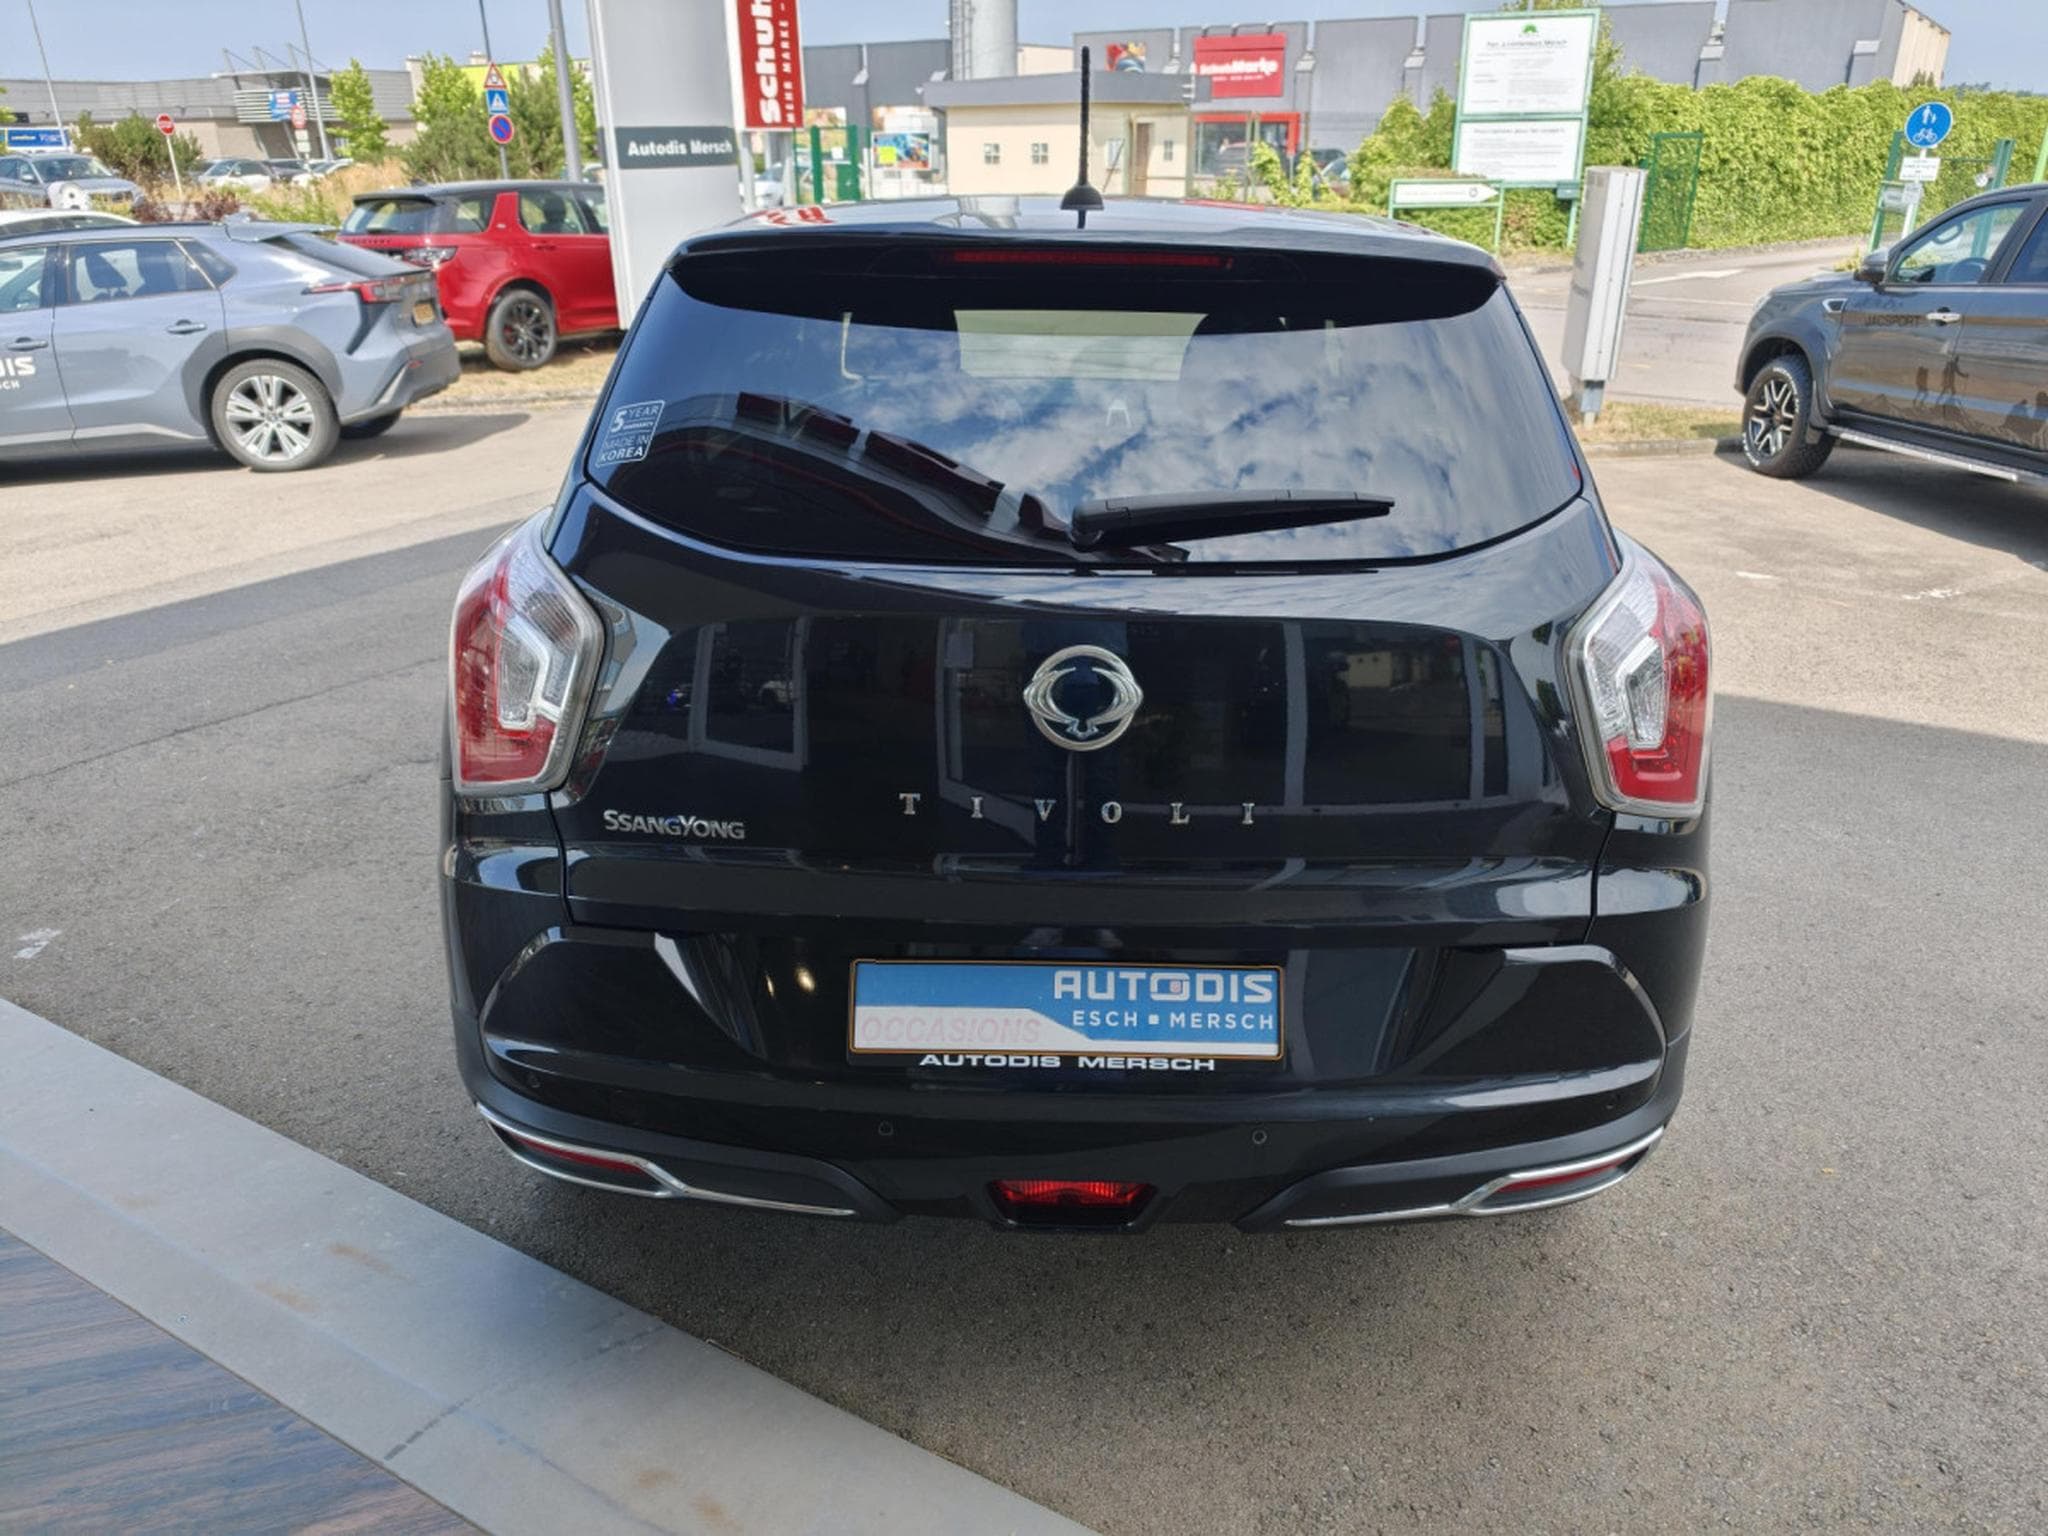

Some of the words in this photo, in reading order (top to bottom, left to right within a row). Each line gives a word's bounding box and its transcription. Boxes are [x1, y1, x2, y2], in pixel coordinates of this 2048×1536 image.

[779, 20, 792, 74] MARKE
[628, 139, 687, 156] Autodis
[690, 139, 733, 154] Mersch
[0, 356, 36, 376] IS
[610, 410, 628, 433] 5
[628, 405, 660, 418] YEAR
[637, 433, 650, 445] IN
[599, 446, 643, 462] KOREA
[900, 793, 1254, 824] TIVOLI
[1054, 970, 1273, 1004] AUTODIS
[861, 1016, 1042, 1044] OCCASIONS
[1072, 1010, 1138, 1027] ESCH
[1170, 1013, 1273, 1030] MERSCH
[919, 1054, 1061, 1068] AUTODIS
[1078, 1056, 1216, 1071] MERSCH
